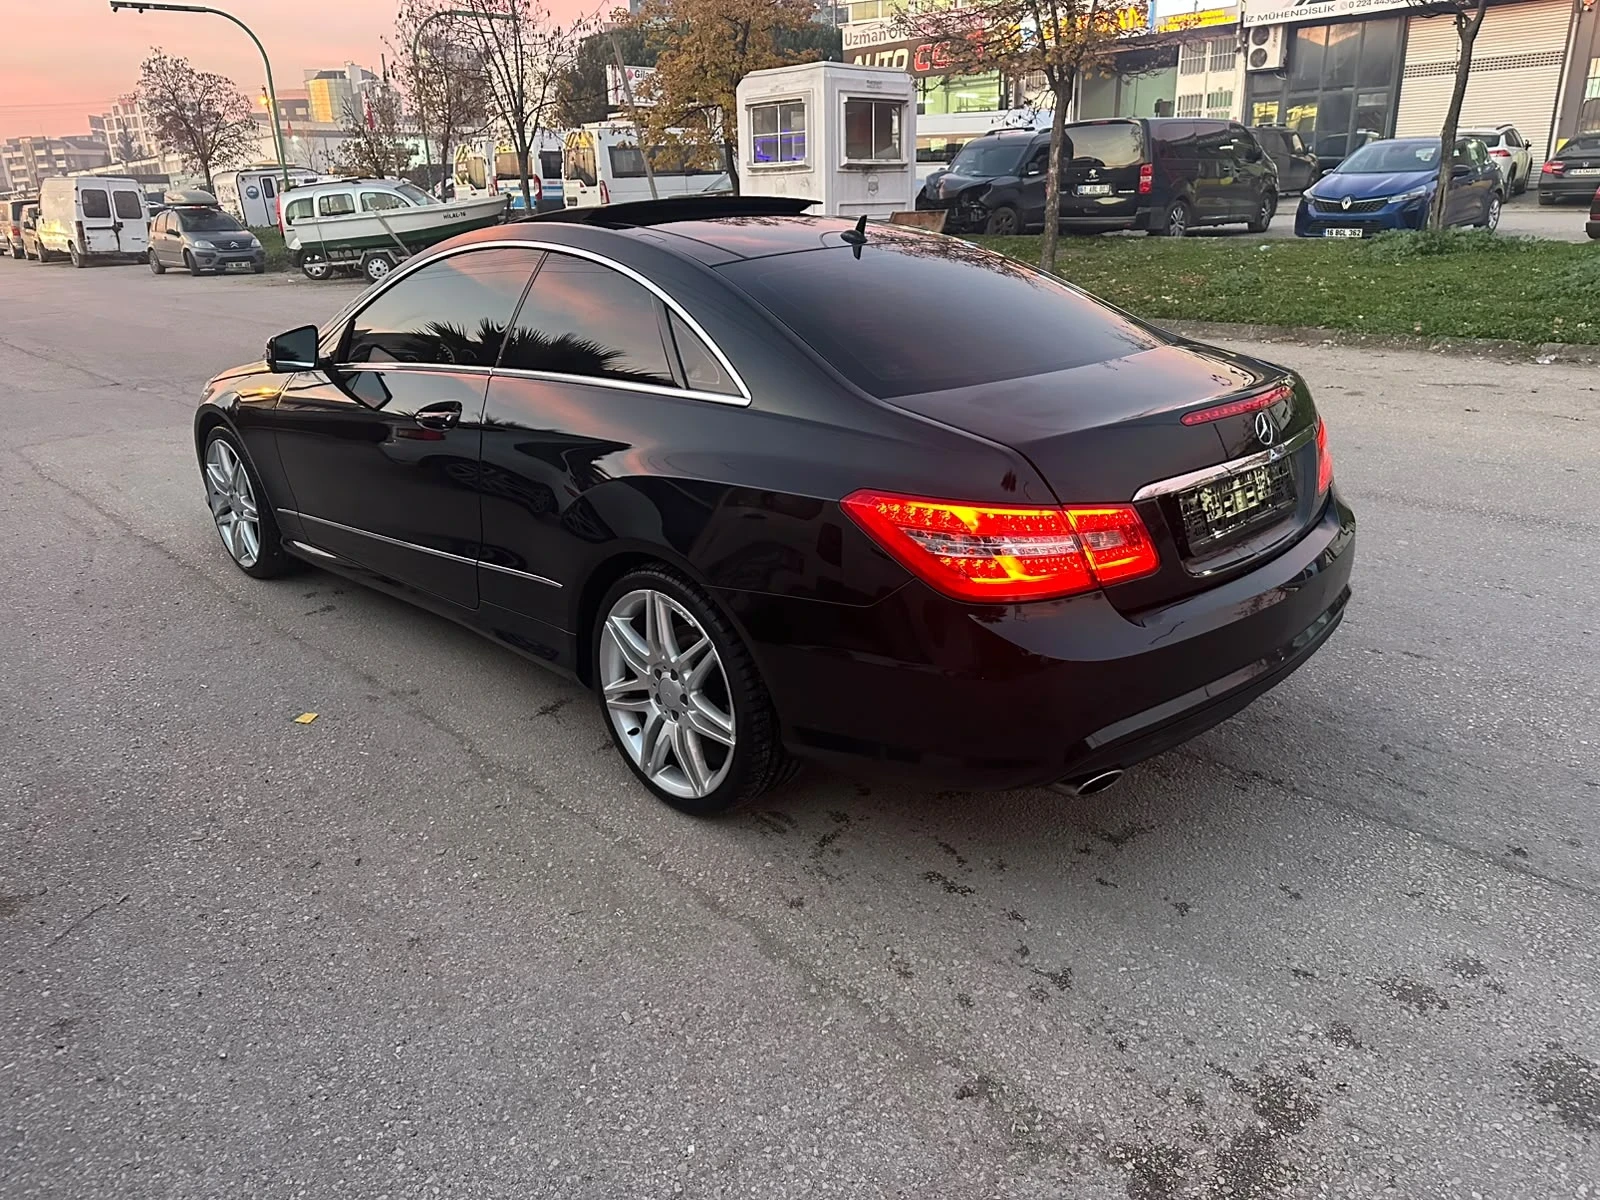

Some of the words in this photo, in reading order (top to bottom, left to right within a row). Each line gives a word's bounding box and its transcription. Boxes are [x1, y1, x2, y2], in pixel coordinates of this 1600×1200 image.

[1257, 4, 1336, 21] MÜHENDİSLİK
[844, 30, 887, 47] Uzman
[853, 48, 909, 71] AUTO
